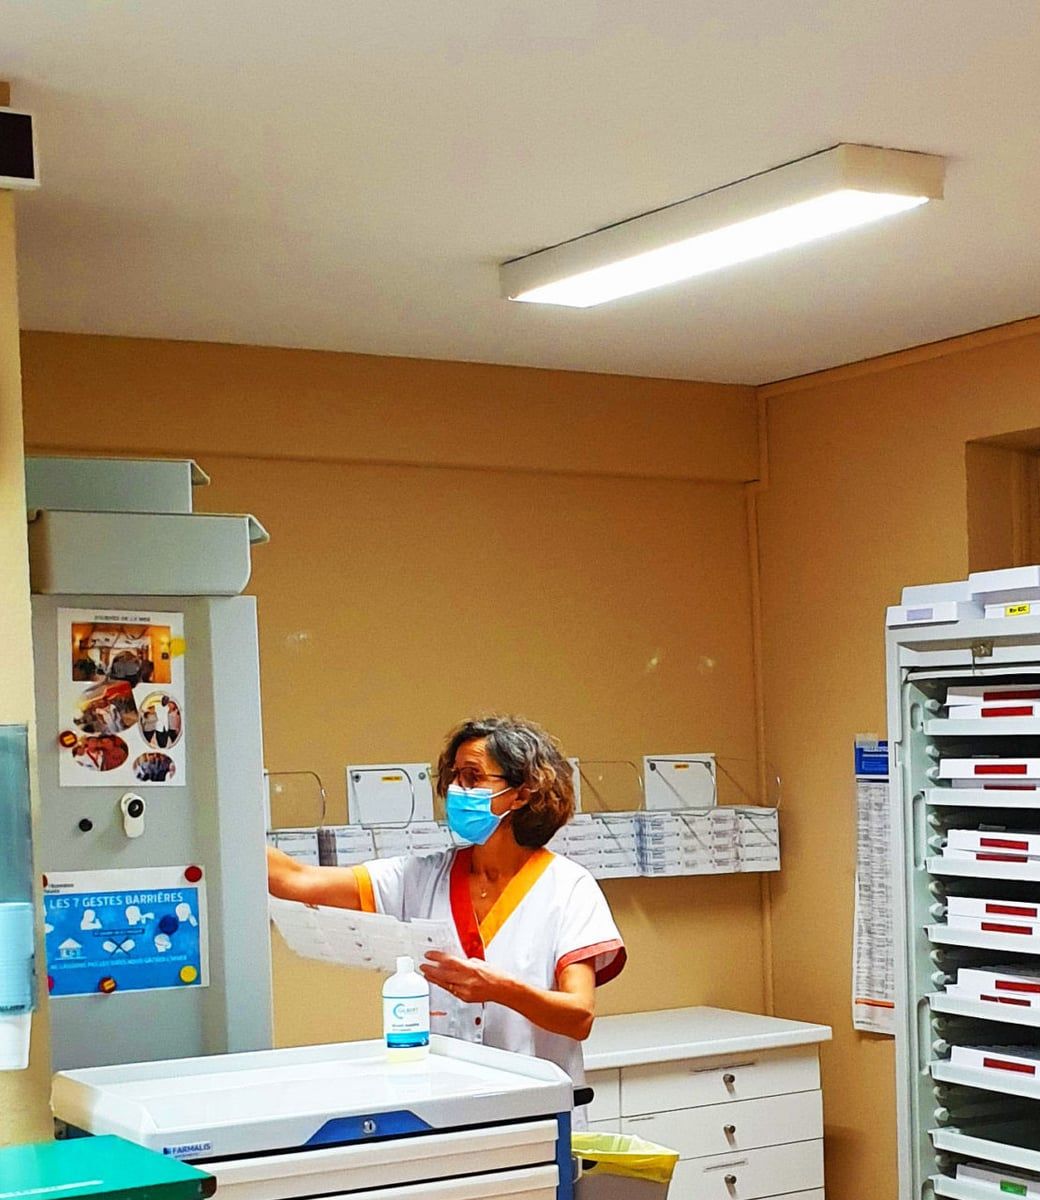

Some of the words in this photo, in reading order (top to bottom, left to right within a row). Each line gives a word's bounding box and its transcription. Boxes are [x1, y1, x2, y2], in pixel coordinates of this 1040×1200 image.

[49, 898, 70, 909] LES
[72, 897, 79, 908] 7
[82, 895, 122, 908] GESTES
[125, 891, 183, 905] BARRIÈRES
